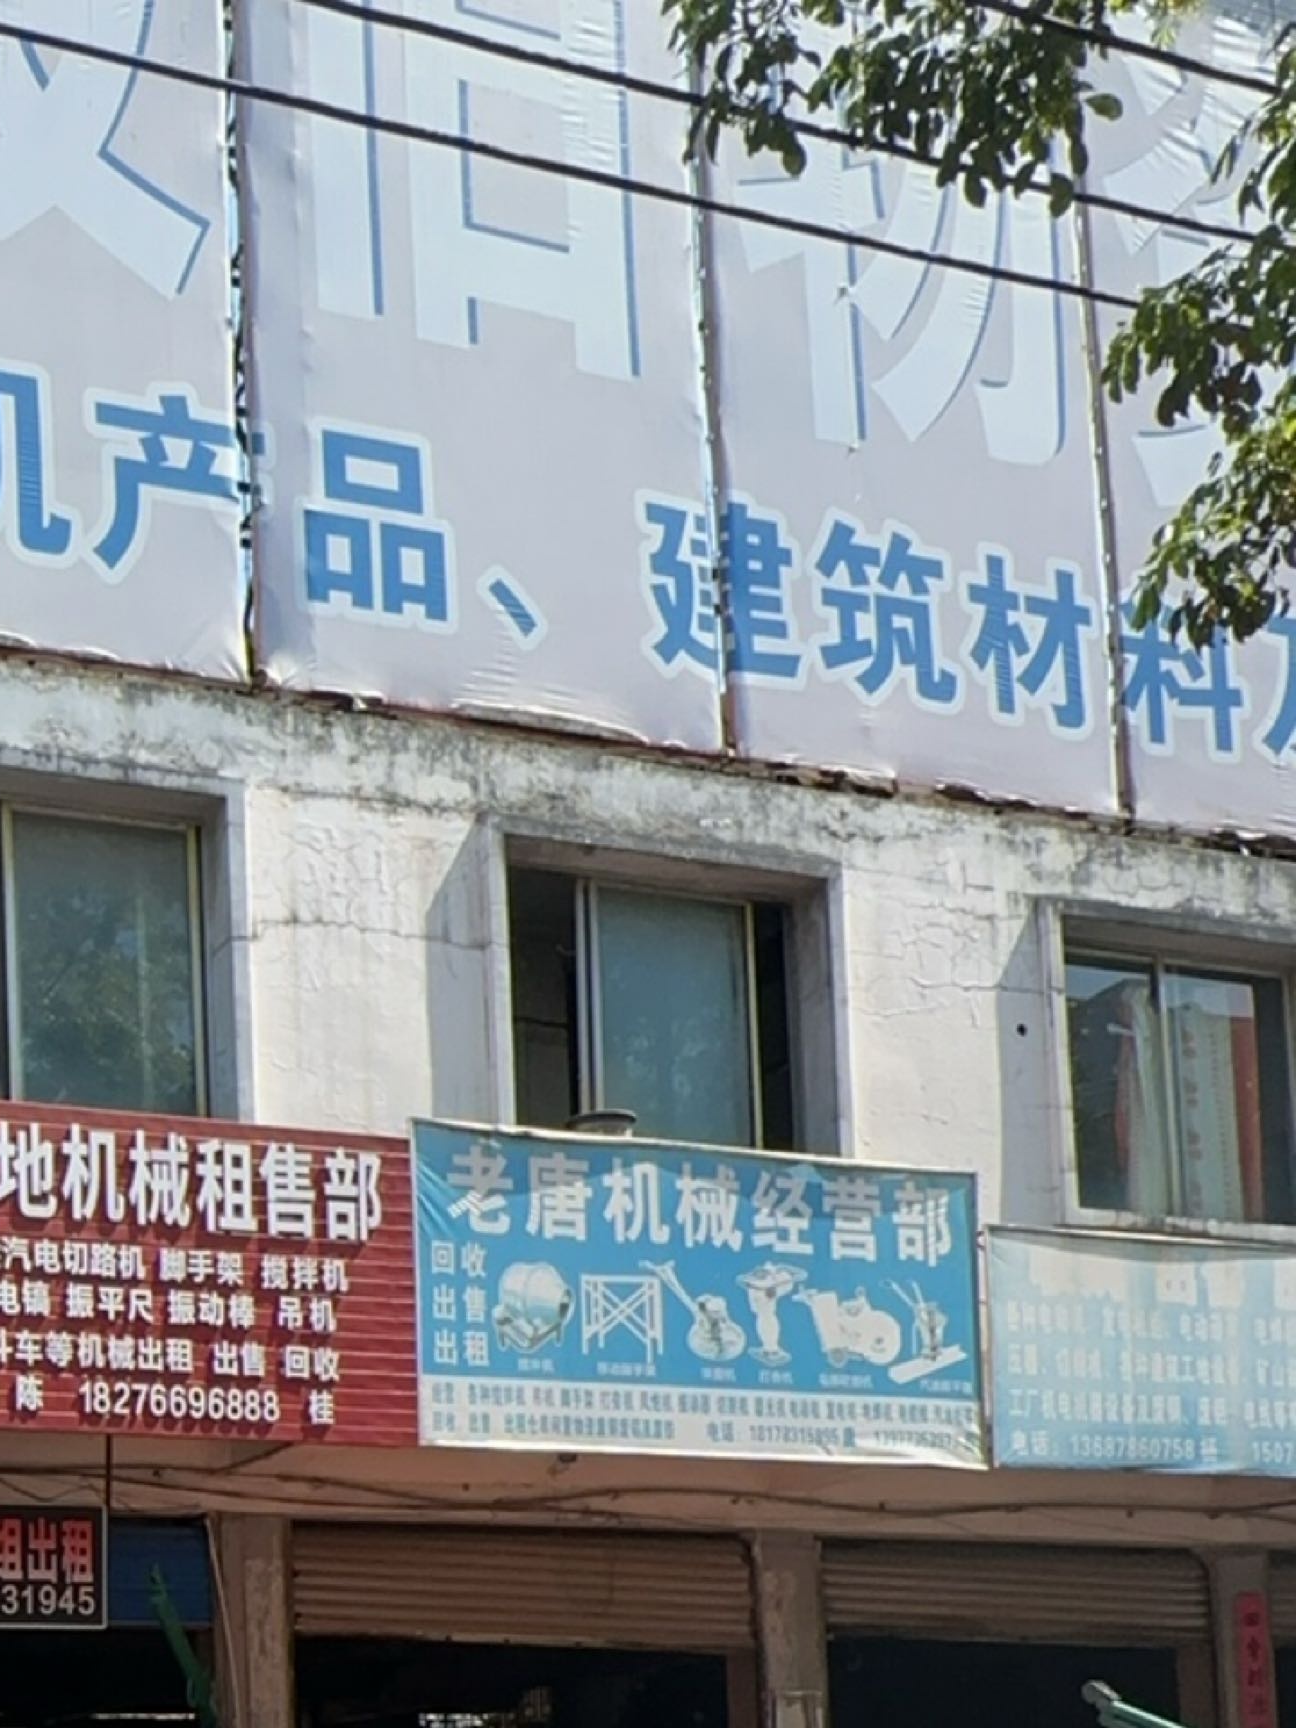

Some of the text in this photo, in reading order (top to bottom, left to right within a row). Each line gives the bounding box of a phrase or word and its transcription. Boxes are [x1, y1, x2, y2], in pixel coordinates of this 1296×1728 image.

[446, 1138, 953, 1268] 老唐机械经营部
[431, 1240, 487, 1278] 回收
[277, 1295, 337, 1333] 吊机
[432, 1283, 487, 1324] 出售
[212, 1339, 266, 1377] 出售
[283, 1345, 340, 1382] 回收
[434, 1328, 490, 1367] 出租
[78, 1378, 281, 1423] 18276696888
